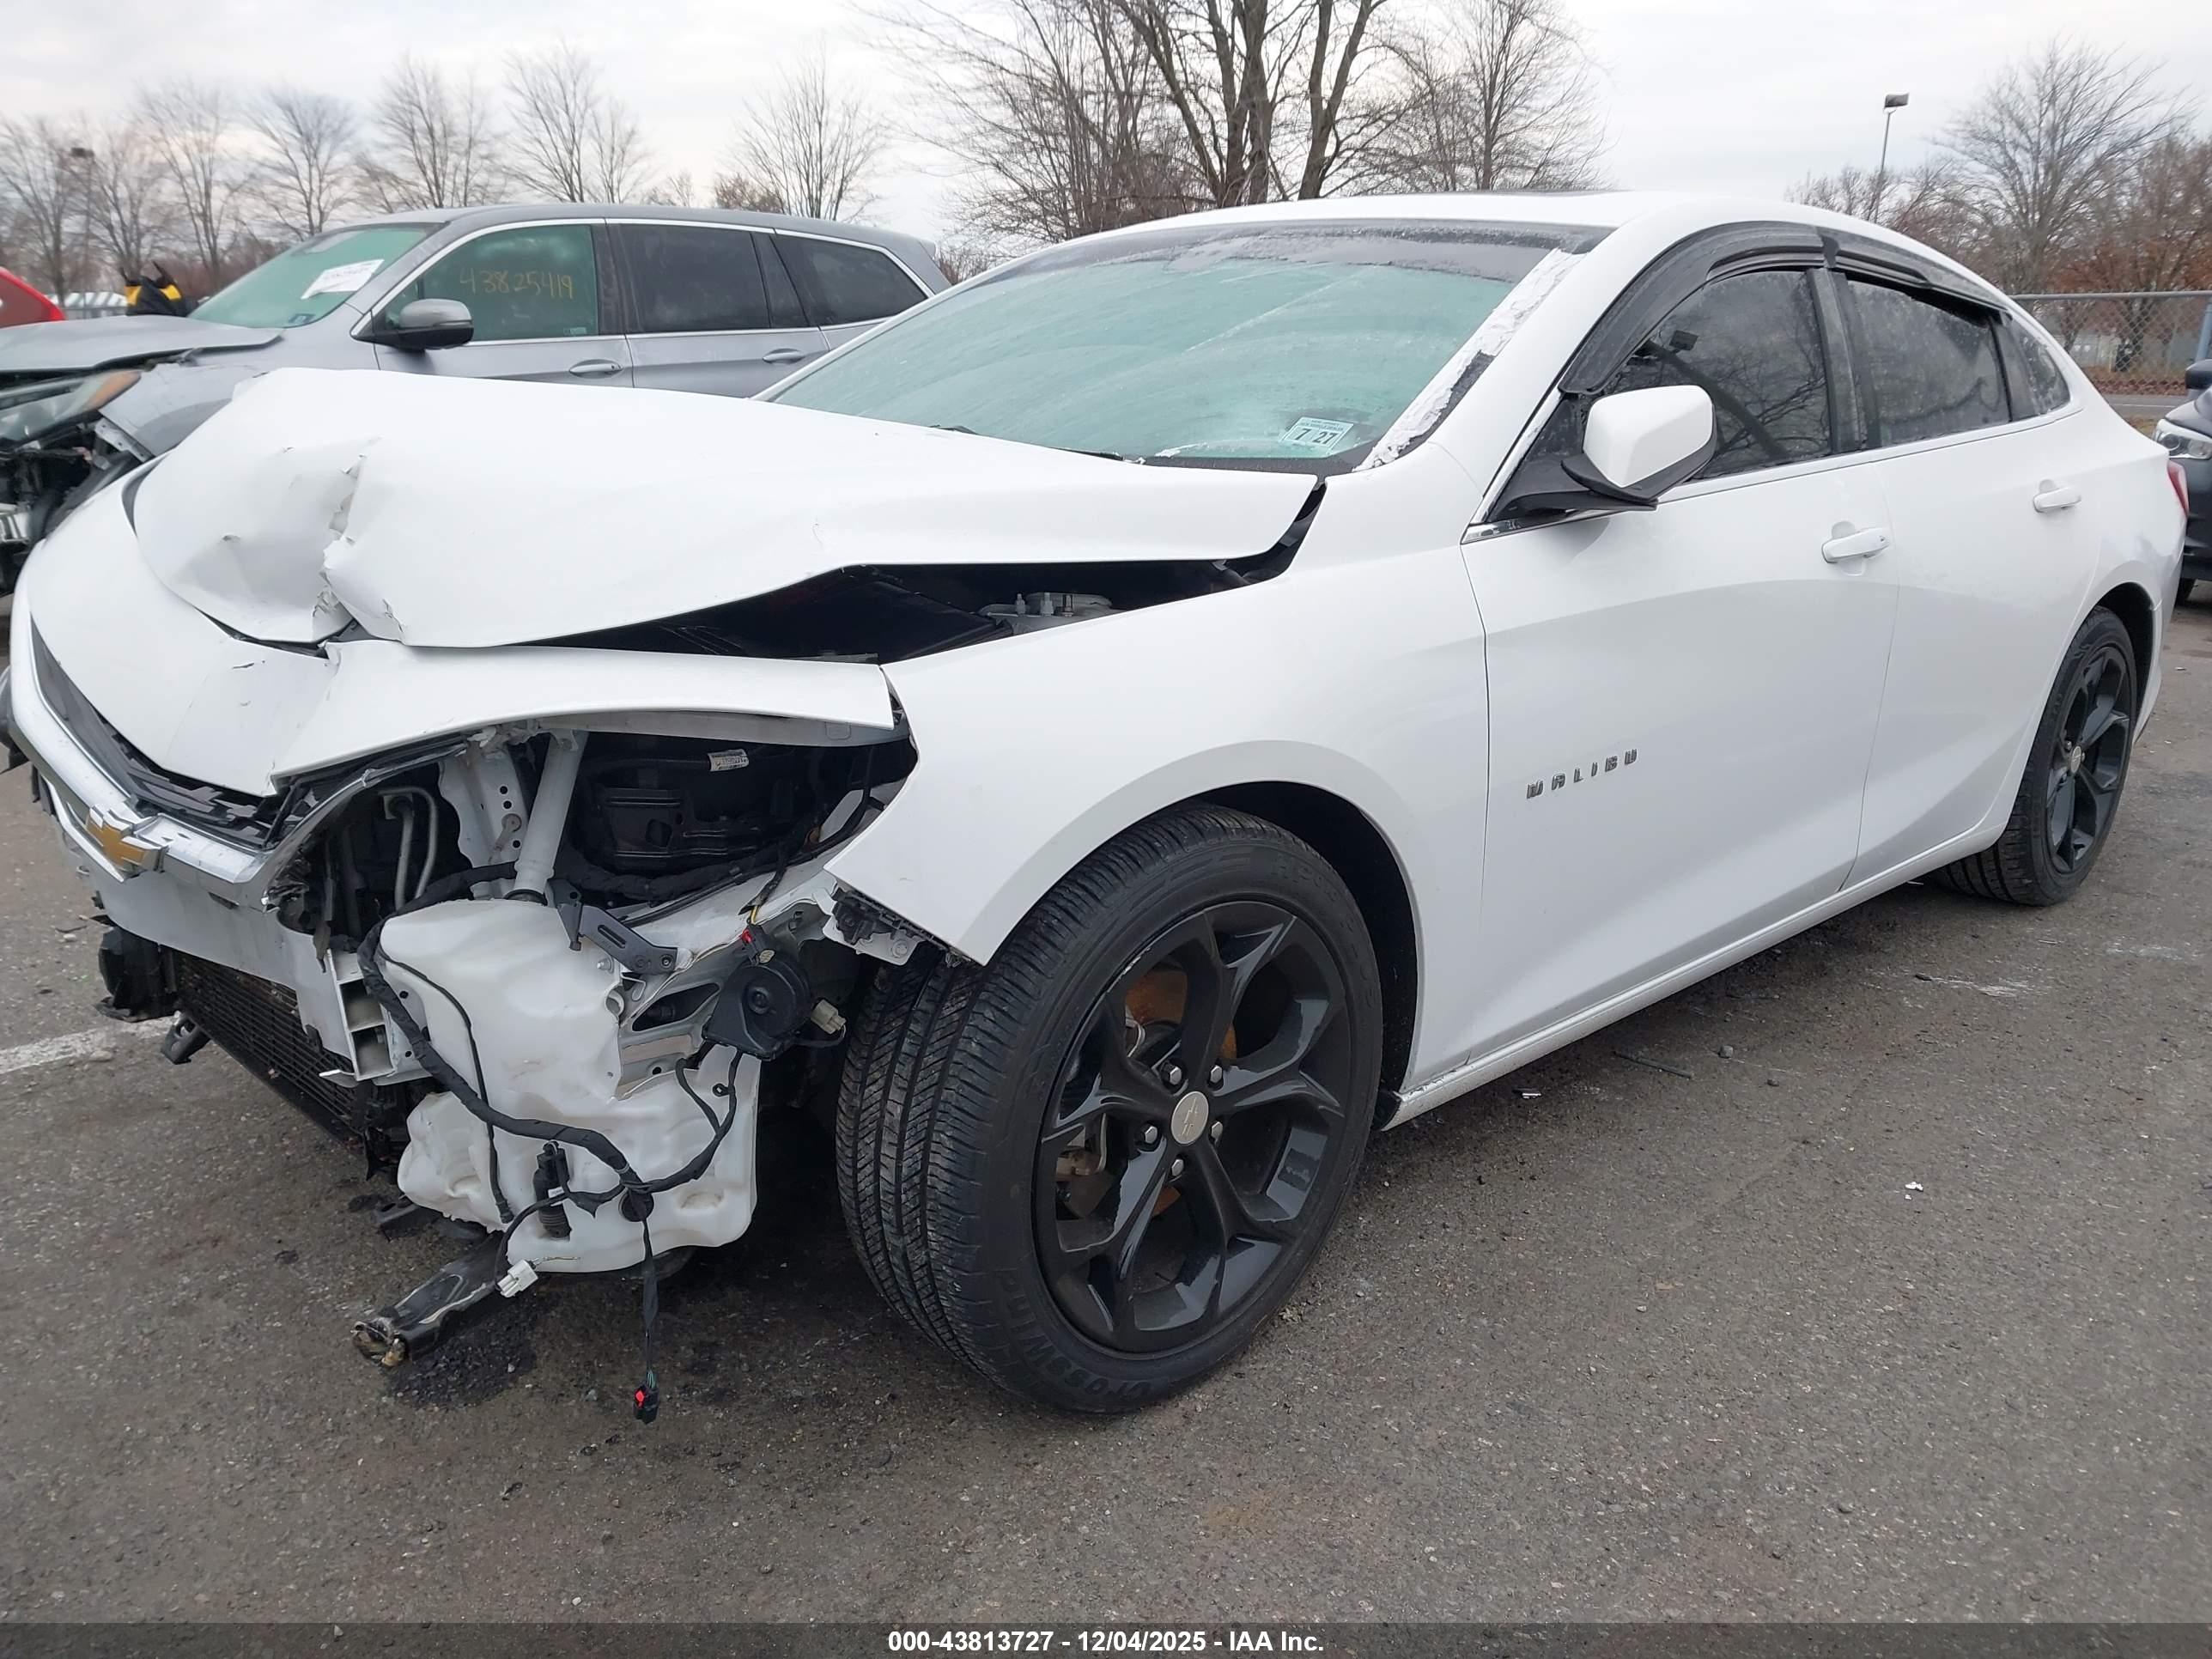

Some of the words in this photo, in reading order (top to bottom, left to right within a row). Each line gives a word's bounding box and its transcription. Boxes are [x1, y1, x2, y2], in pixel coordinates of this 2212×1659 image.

[459, 267, 574, 300] 43825419
[1294, 428, 1313, 441] 7
[1312, 431, 1339, 445] 27
[1526, 748, 1638, 799] MALIBU
